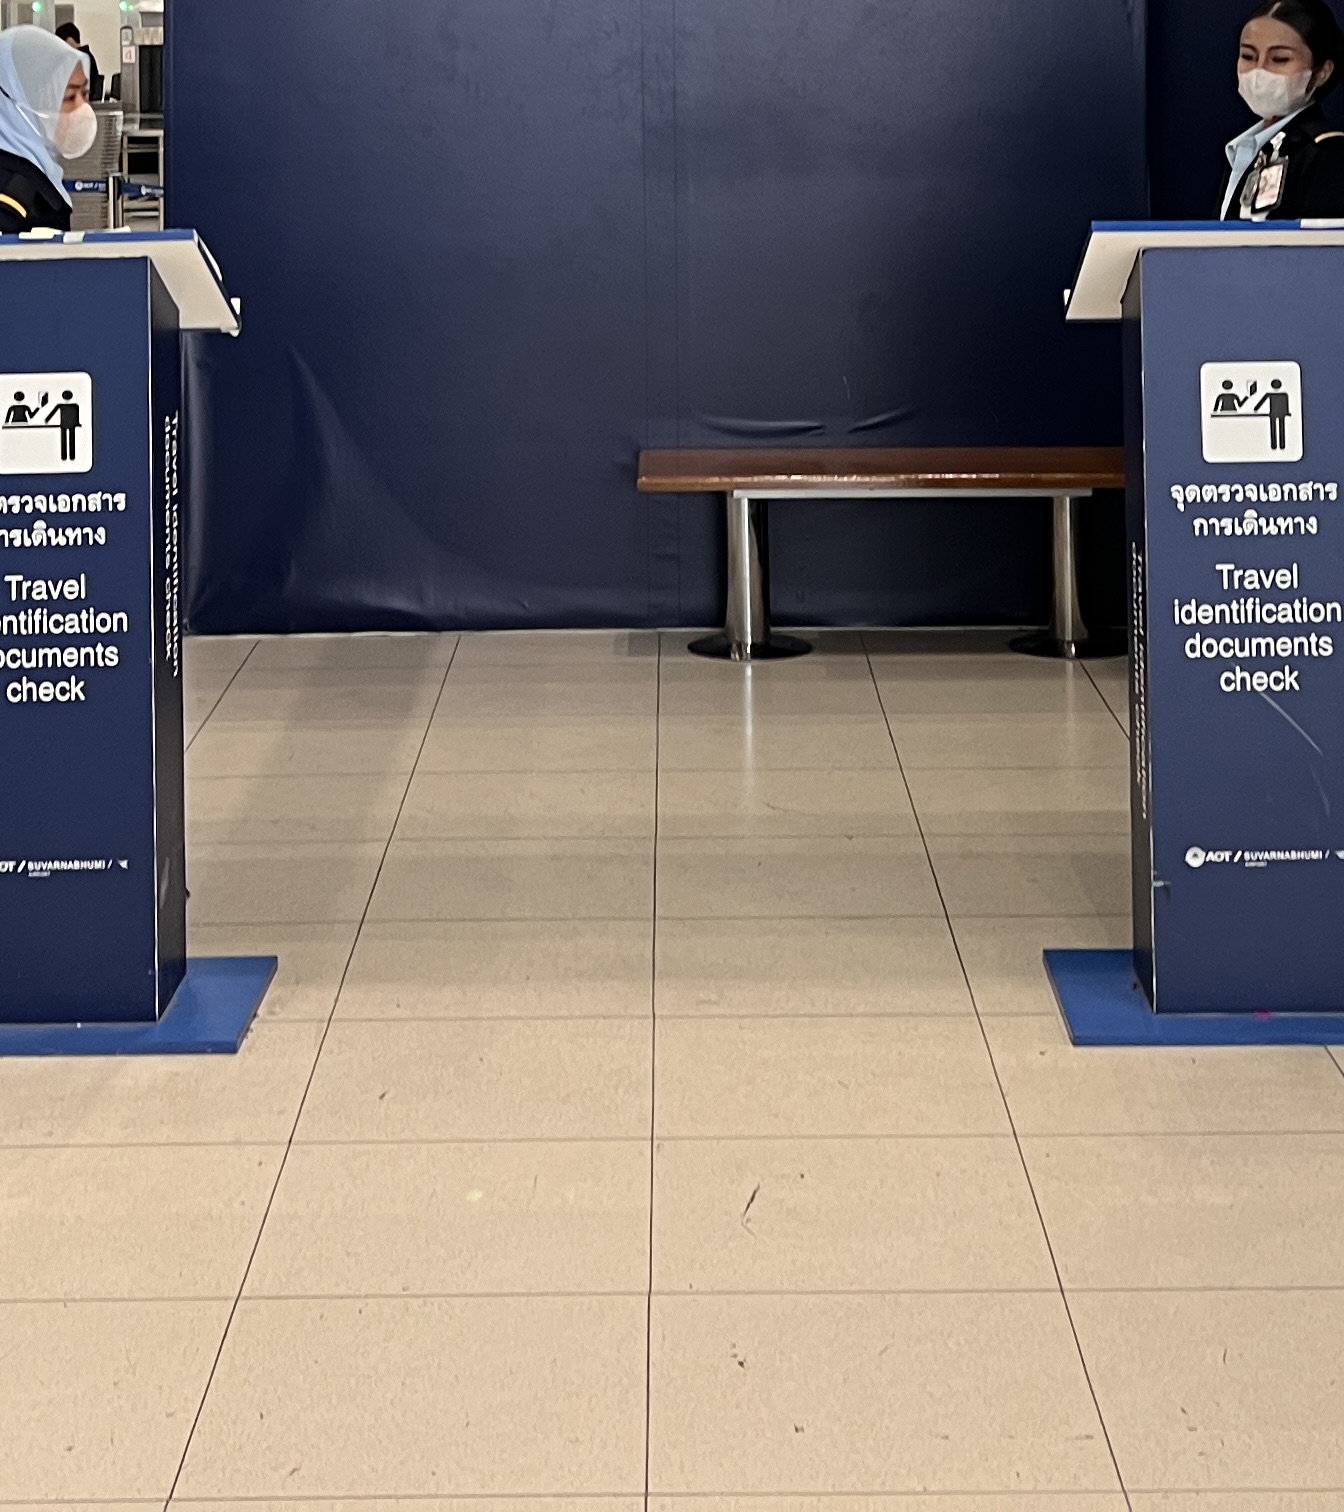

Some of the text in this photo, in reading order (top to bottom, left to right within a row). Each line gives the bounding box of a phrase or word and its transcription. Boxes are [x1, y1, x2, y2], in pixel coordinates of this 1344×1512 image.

[1170, 480, 1338, 512] จุดตรวจเอกสาร
[1192, 509, 1318, 538] การเดินทาง
[3, 573, 86, 601] Travel
[1215, 562, 1298, 590] Travel
[1174, 596, 1342, 625] identification
[1184, 632, 1334, 659] documents
[6, 675, 86, 703] check
[1219, 664, 1300, 692] check
[1205, 850, 1232, 862] AOT
